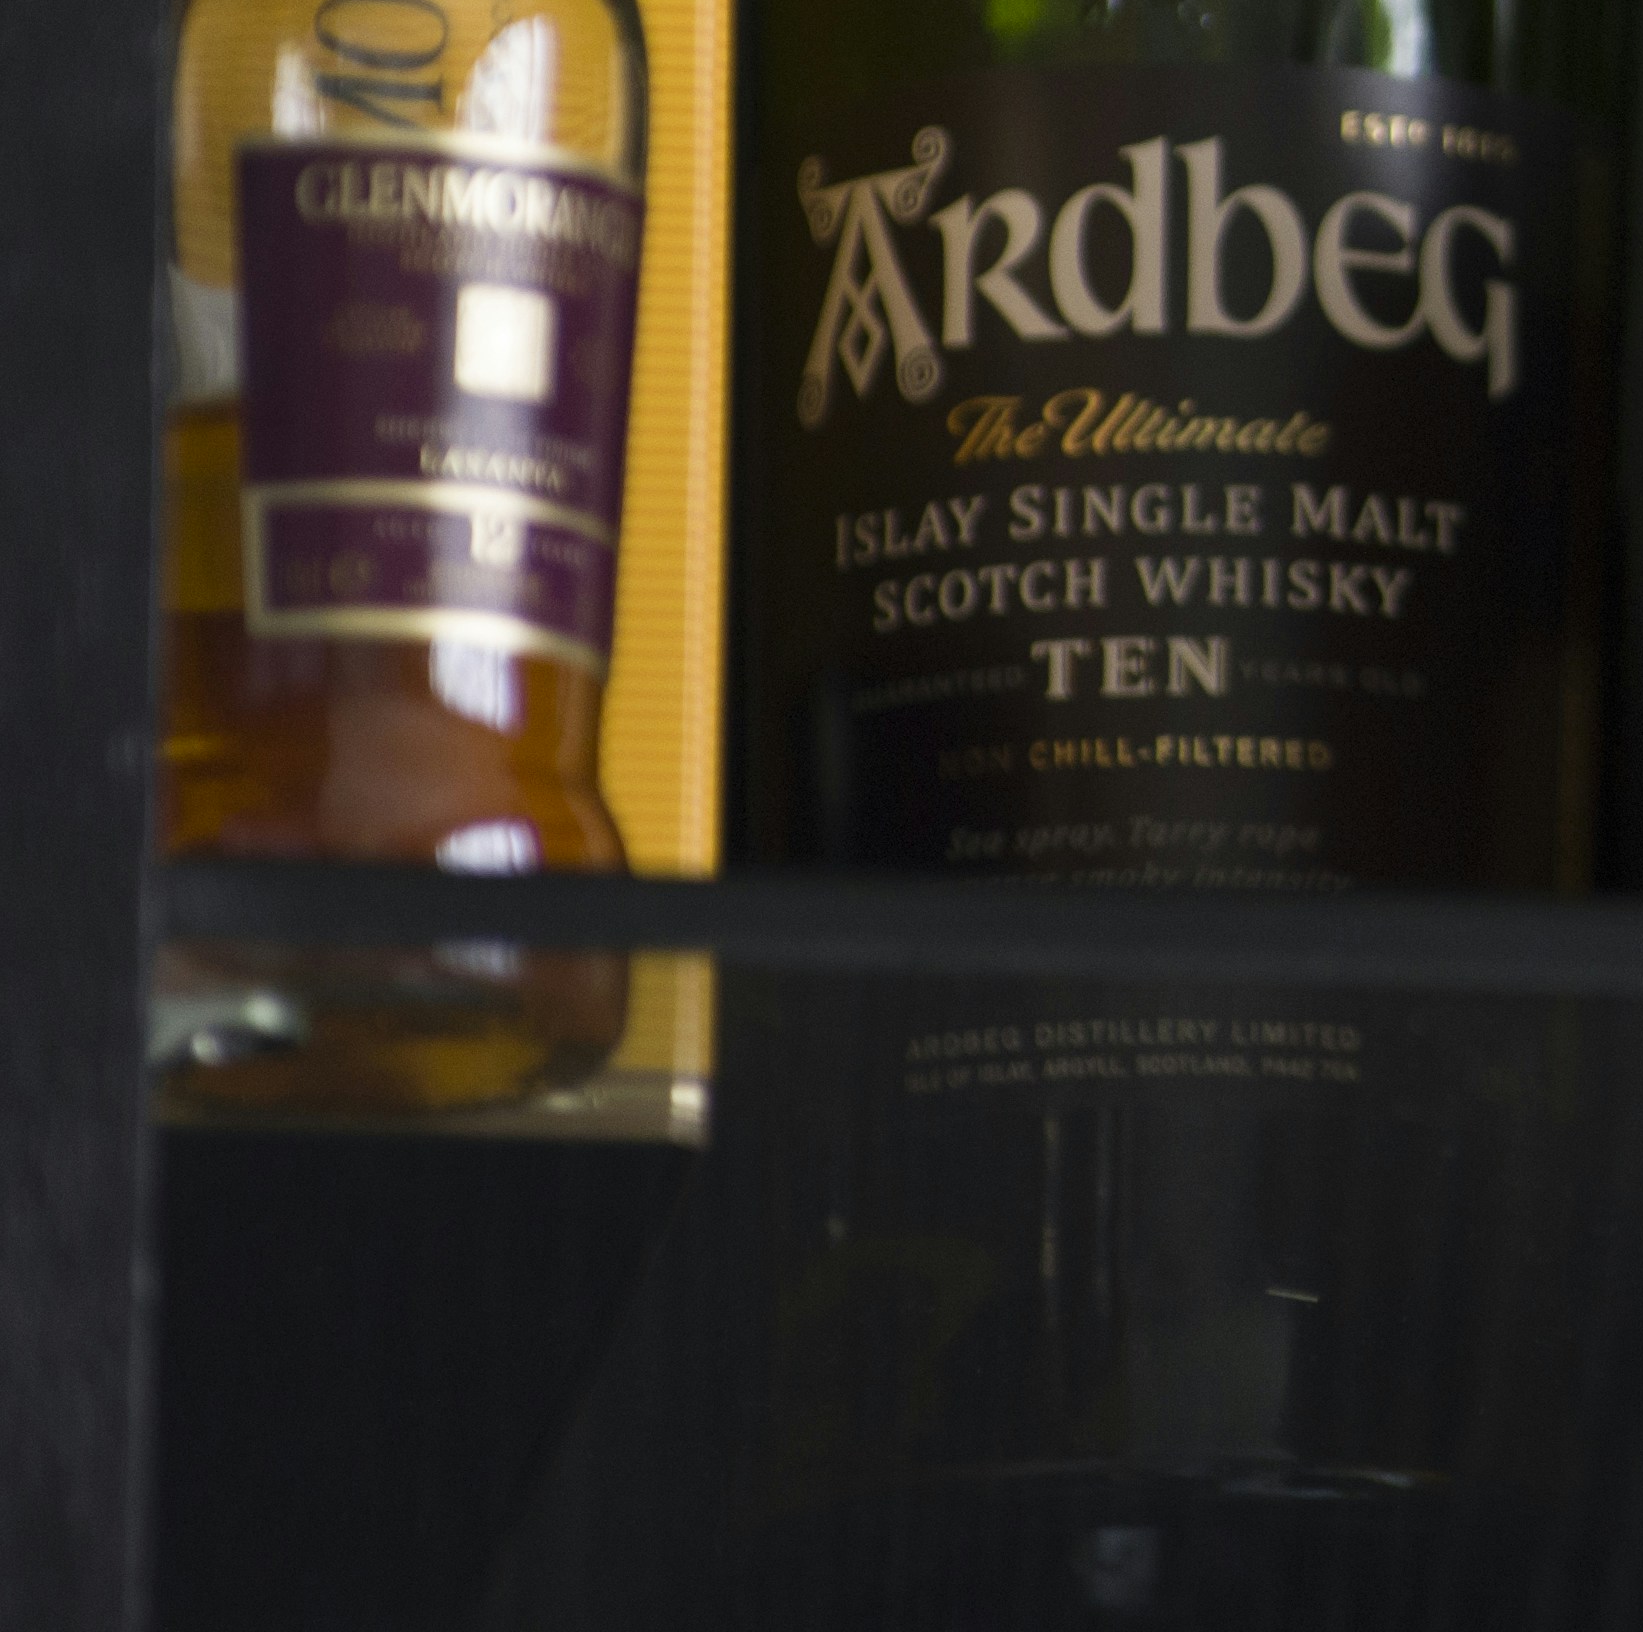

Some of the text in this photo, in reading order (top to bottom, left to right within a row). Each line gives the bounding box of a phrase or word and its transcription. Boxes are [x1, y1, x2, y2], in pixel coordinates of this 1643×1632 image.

[946, 387, 1332, 466] The Ultimate
[835, 484, 1466, 568] ISLAY SINGLE MALT
[872, 556, 1411, 633] SCOTCH WHISKY
[1030, 635, 1230, 702] TEN
[1029, 734, 1334, 770] CHILL-FILTERED
